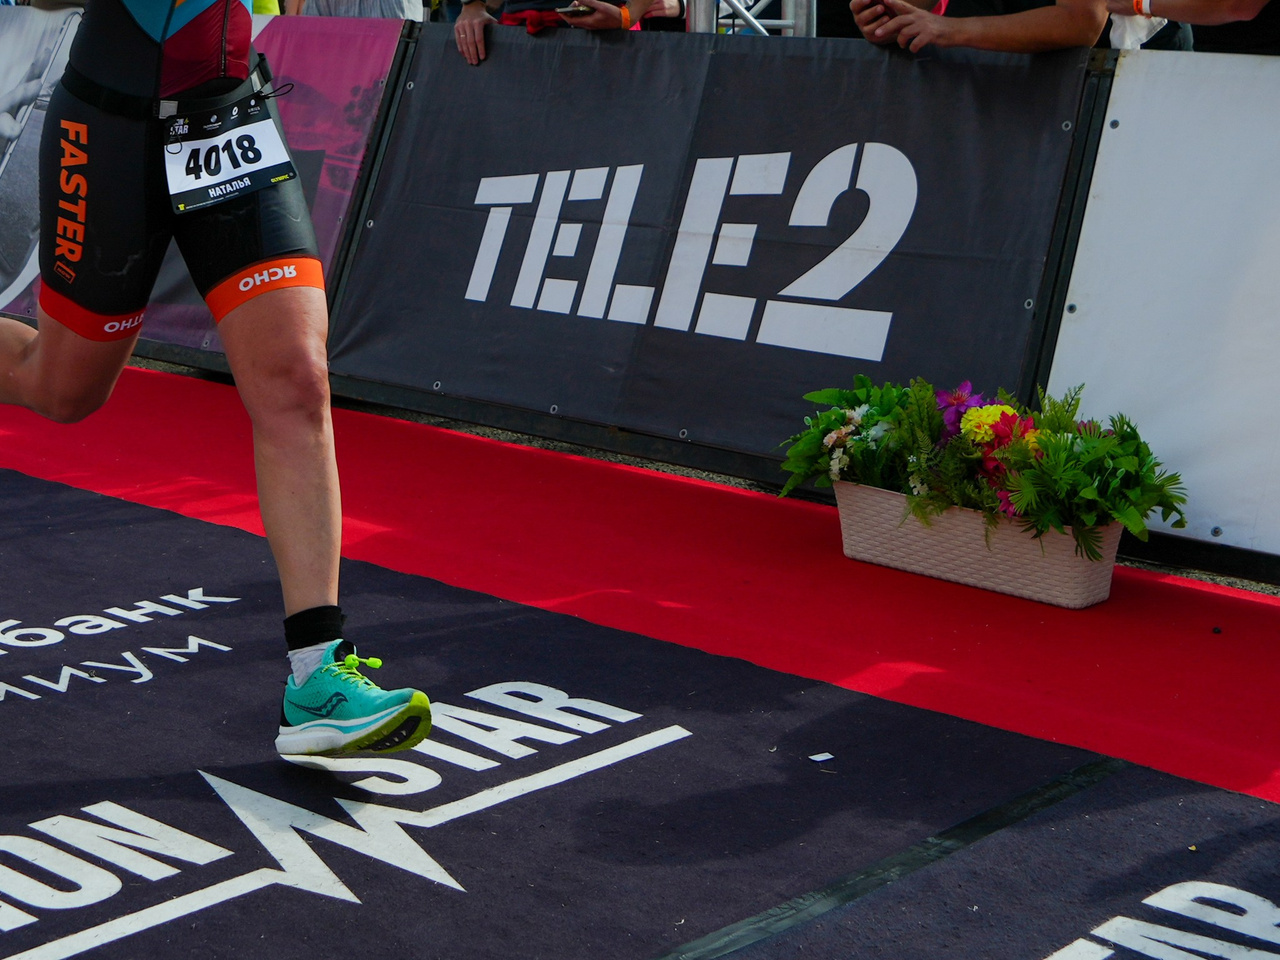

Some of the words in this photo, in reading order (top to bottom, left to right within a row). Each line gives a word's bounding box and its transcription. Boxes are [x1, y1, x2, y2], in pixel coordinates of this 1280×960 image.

[185, 134, 262, 180] 4018
[55, 119, 88, 262] FASTER
[208, 177, 251, 198] НАТАЛЬЯ
[464, 141, 919, 362] TELE2
[238, 264, 297, 293] ЯСНО
